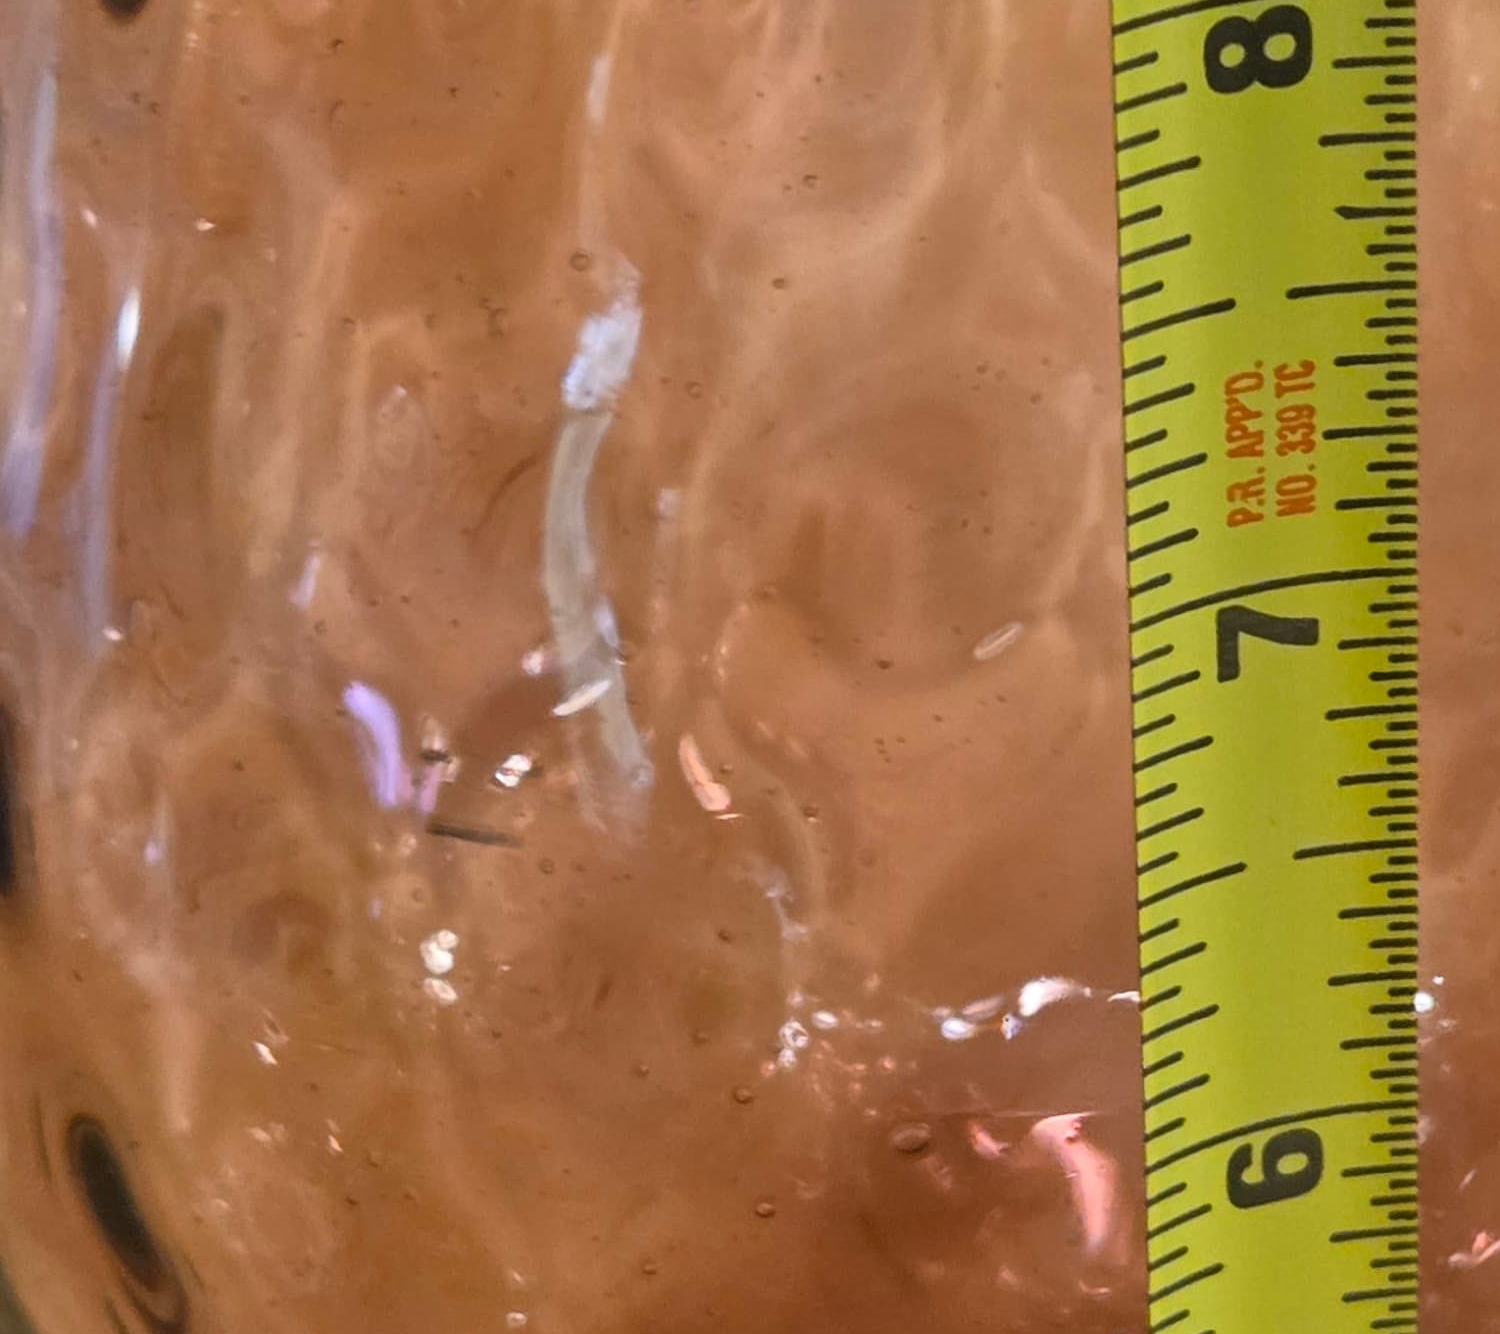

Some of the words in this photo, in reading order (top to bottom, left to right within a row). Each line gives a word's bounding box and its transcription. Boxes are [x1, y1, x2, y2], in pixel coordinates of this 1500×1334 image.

[1203, 4, 1313, 95] 8
[1272, 358, 1317, 400] TC
[1274, 402, 1317, 458] 339
[1274, 463, 1318, 518] NO.
[1215, 603, 1320, 684] 7
[1226, 1128, 1324, 1210] 6
